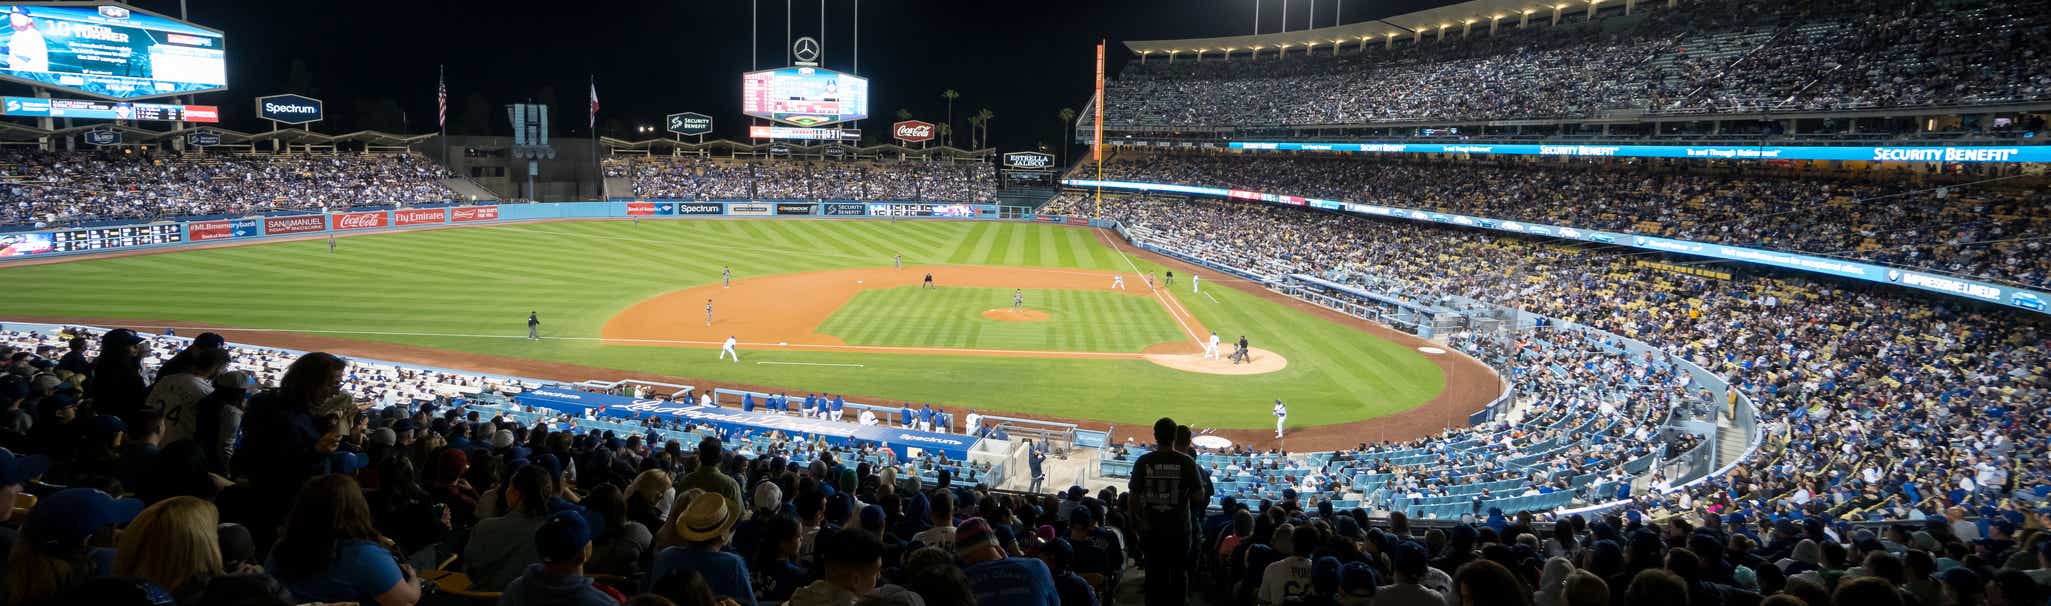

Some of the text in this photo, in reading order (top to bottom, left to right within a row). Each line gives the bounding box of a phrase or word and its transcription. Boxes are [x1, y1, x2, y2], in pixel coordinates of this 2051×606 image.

[266, 103, 315, 114] Spectrum
[1540, 145, 1577, 155] SECURITY
[1873, 147, 1942, 161] SECURITY
[681, 205, 718, 214] Spectrum
[268, 217, 322, 228] SAN MANUEL
[396, 211, 444, 223] Fly Emirates
[1904, 273, 1963, 293] IMPRESSIVE
[899, 433, 963, 446] Spectrum
